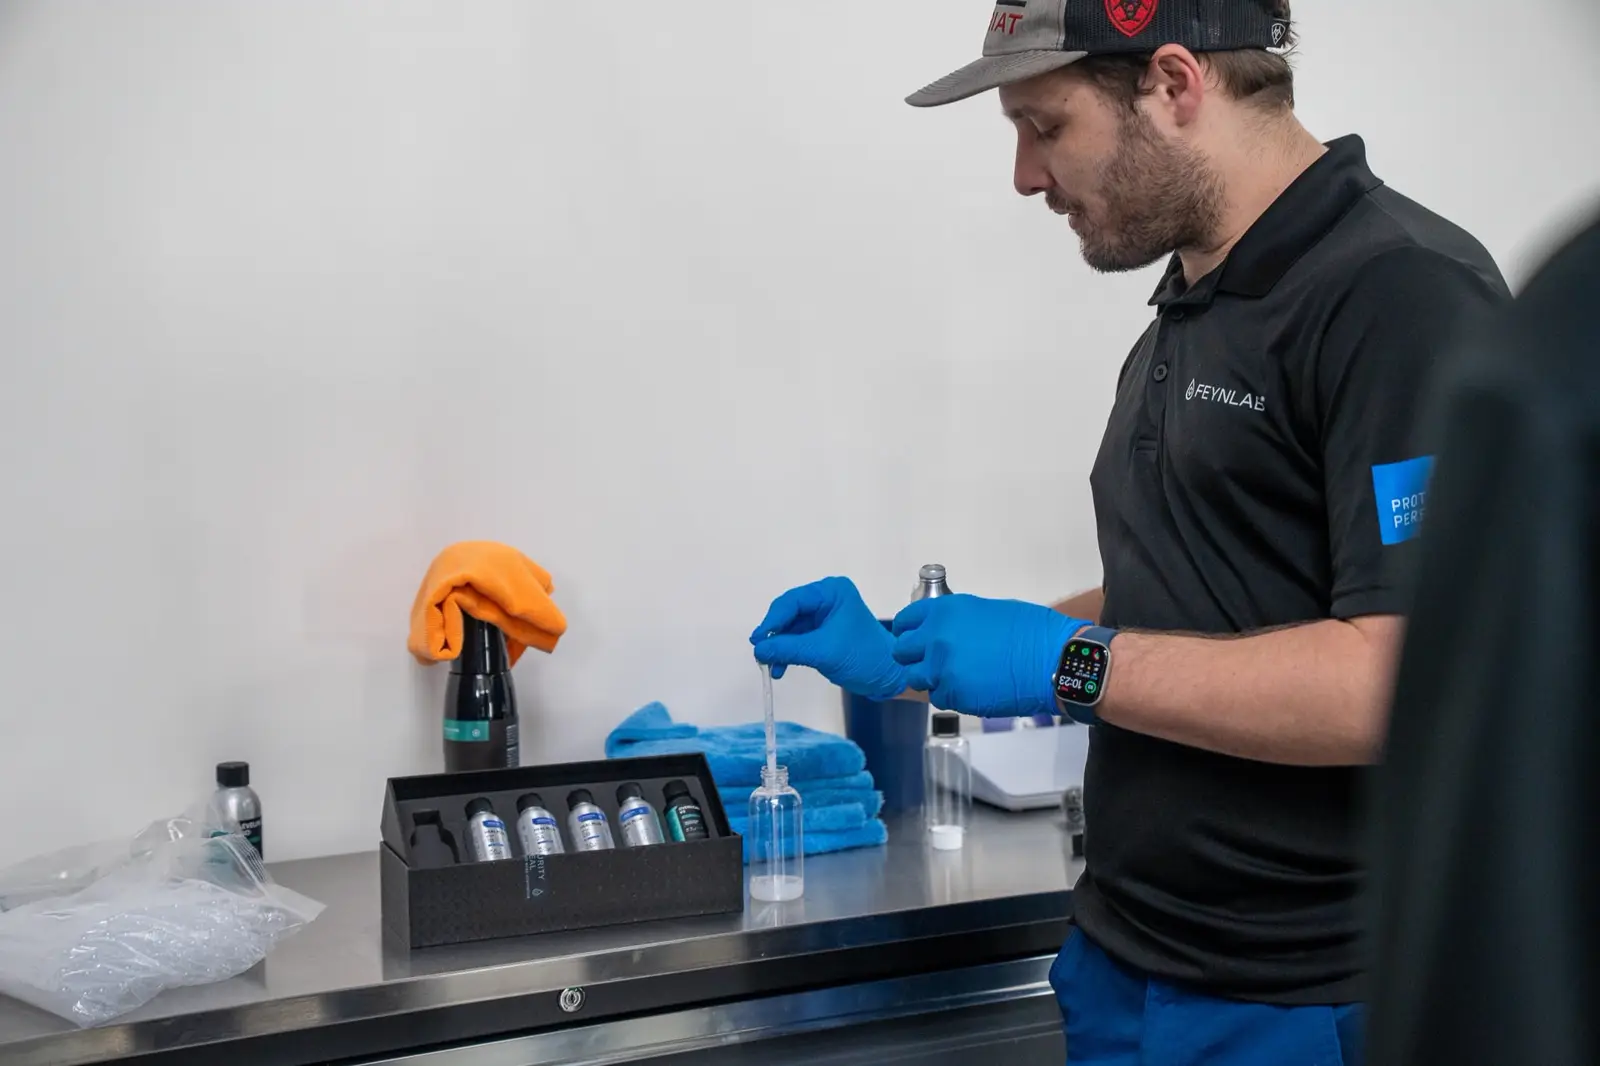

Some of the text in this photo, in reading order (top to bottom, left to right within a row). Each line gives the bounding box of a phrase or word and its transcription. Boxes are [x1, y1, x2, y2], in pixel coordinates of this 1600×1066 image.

[989, 12, 1024, 35] IAT
[1194, 384, 1265, 412] FEYNLAB
[1059, 675, 1082, 690] 10:23
